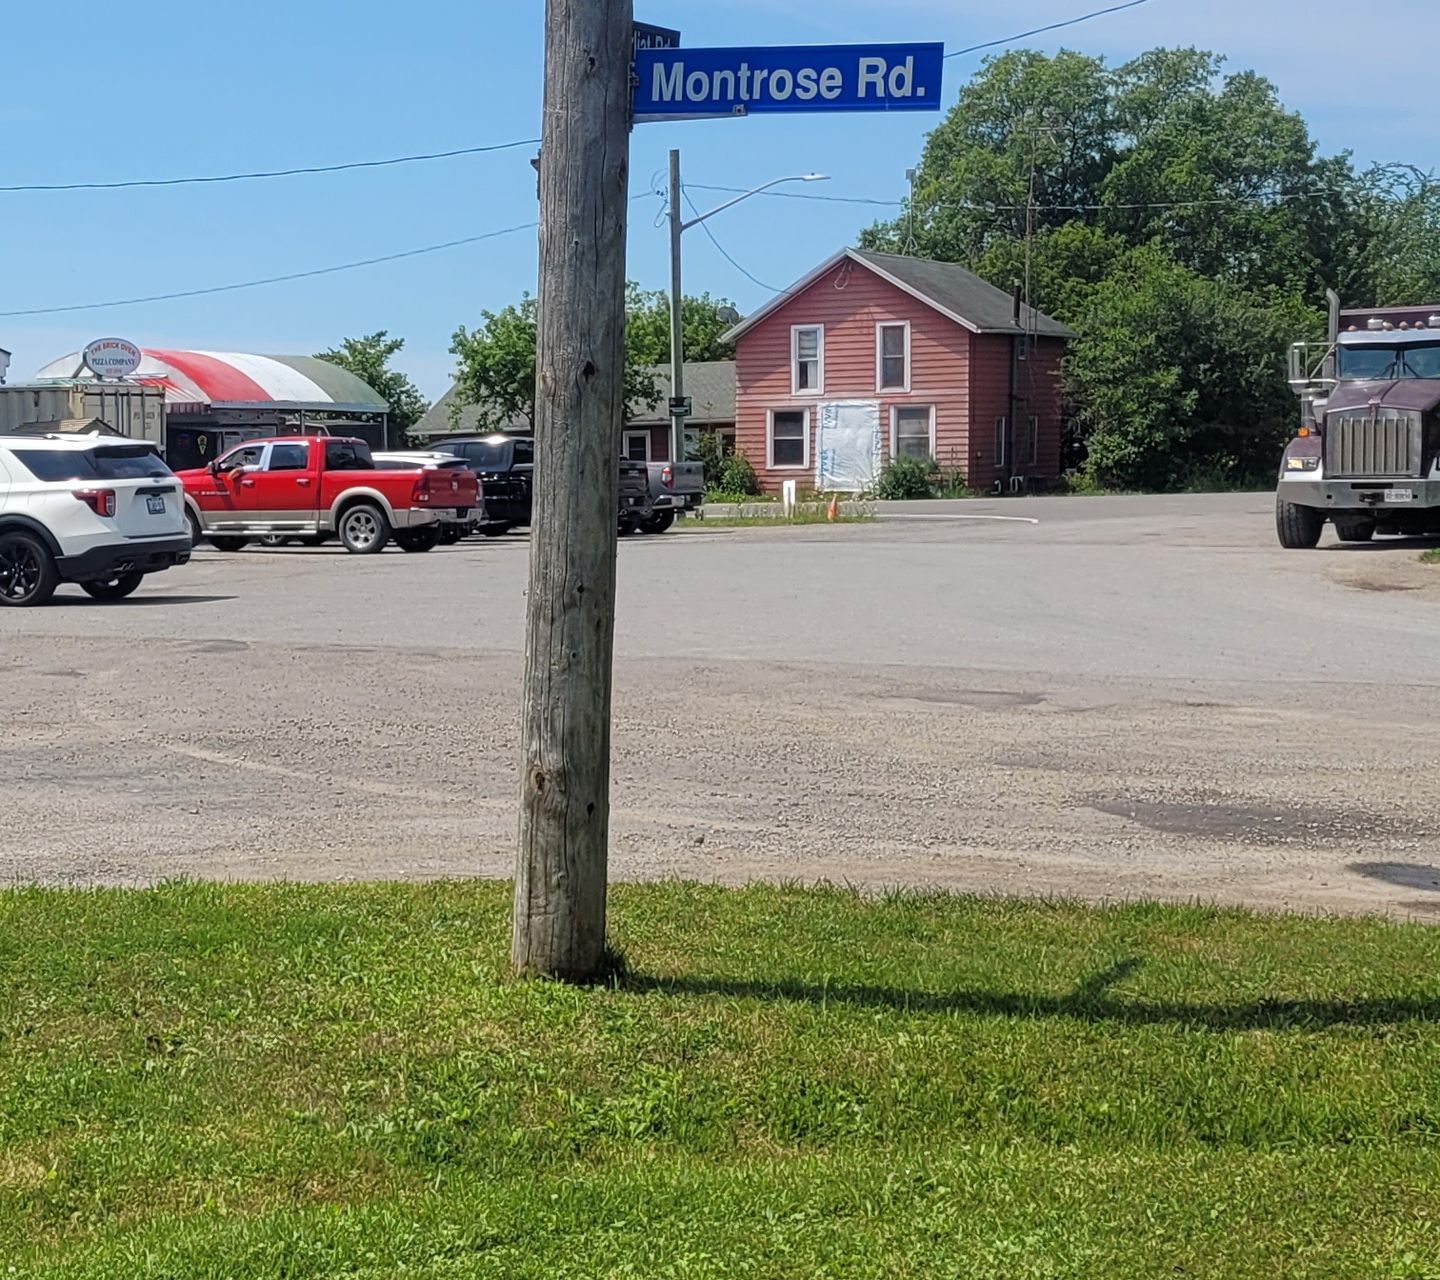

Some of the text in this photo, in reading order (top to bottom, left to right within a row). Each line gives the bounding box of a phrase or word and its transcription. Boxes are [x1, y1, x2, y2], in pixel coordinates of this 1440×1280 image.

[651, 56, 926, 102] Montrose Rd.
[91, 342, 137, 357] THE BRICK OVEN
[91, 358, 135, 366] PIZZA COMPANY
